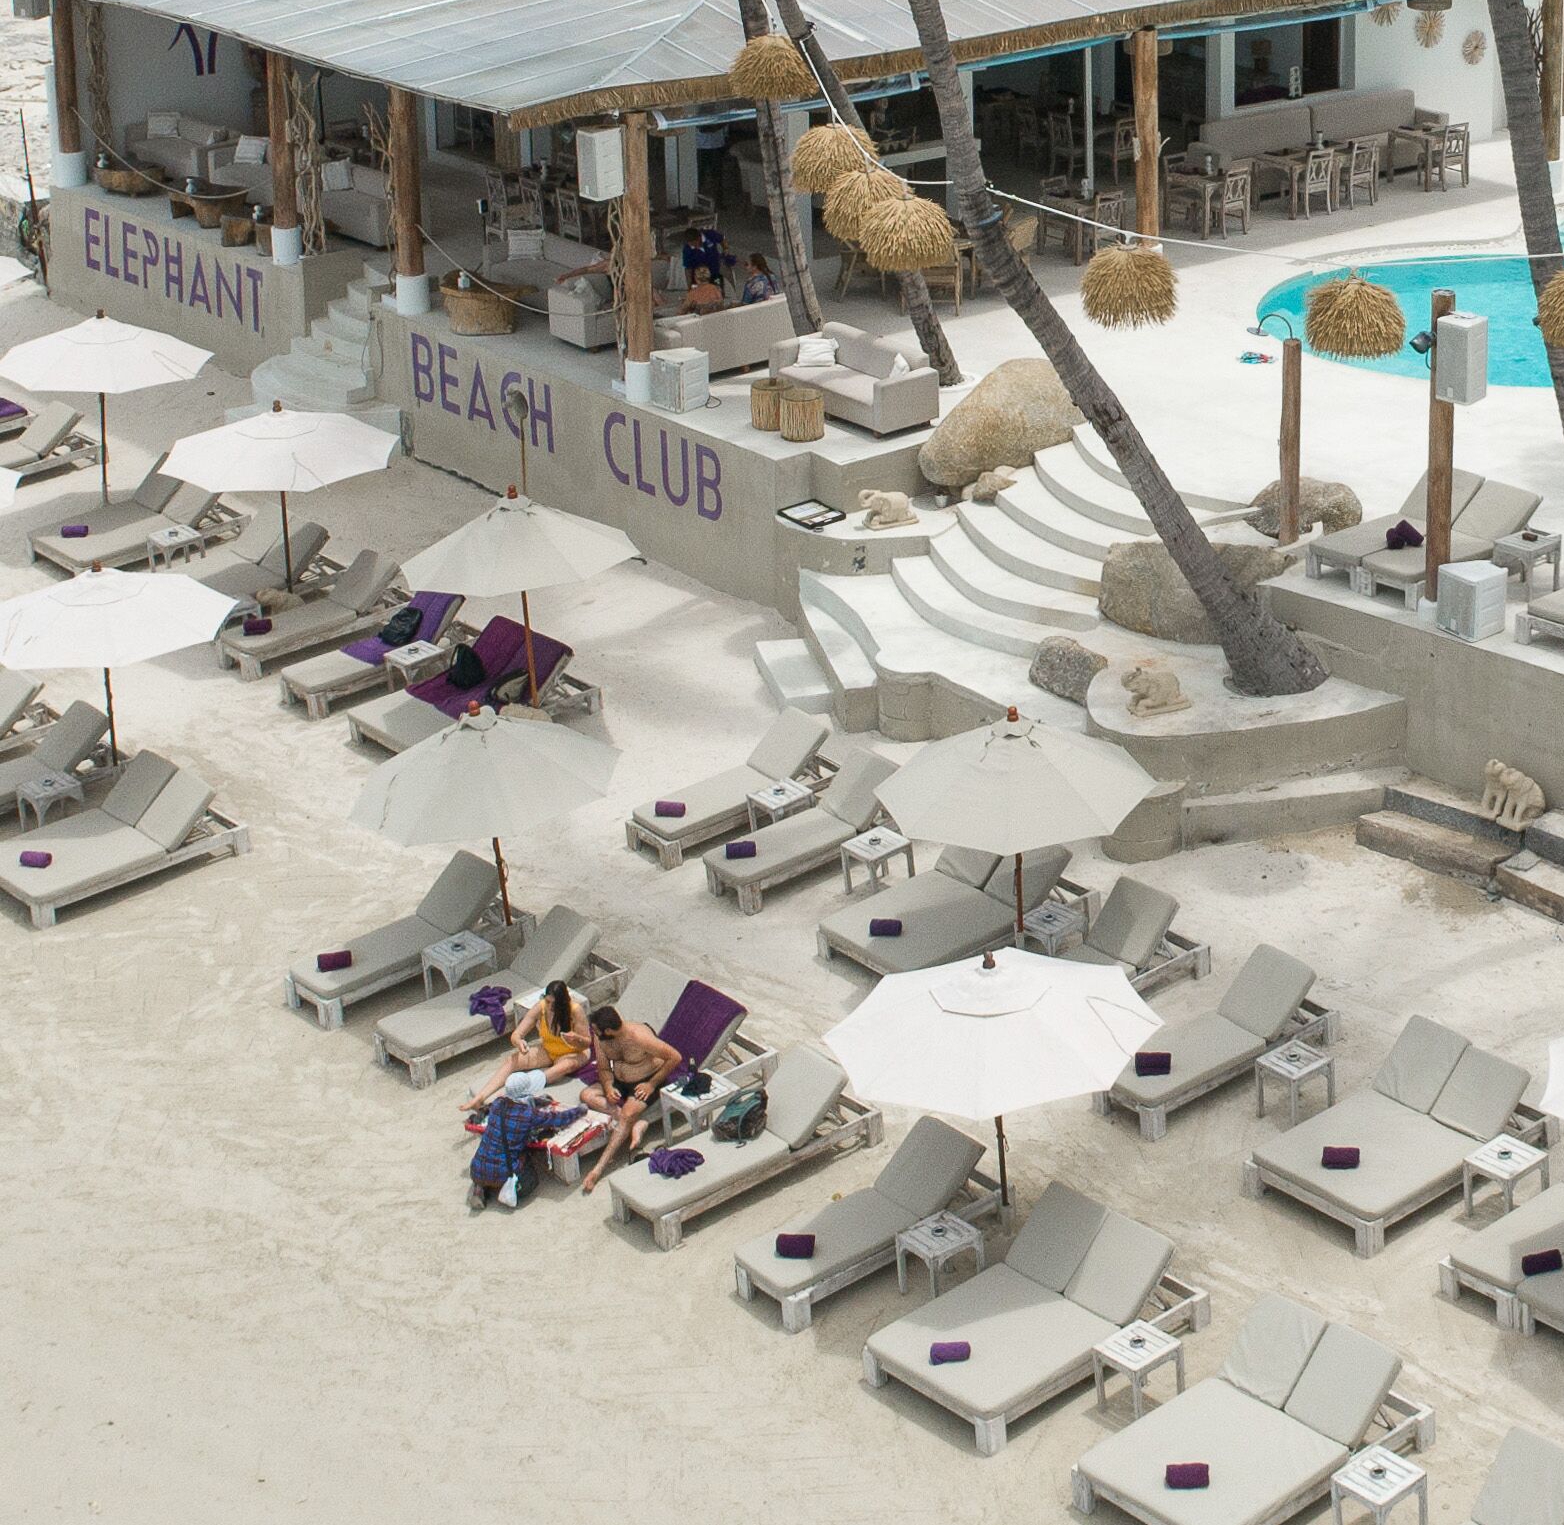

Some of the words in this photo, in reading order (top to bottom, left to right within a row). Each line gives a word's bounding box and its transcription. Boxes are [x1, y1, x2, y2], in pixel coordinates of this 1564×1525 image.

[85, 207, 263, 333] ELEPHANT
[411, 332, 555, 453] BEACH
[603, 411, 723, 521] CLUB
